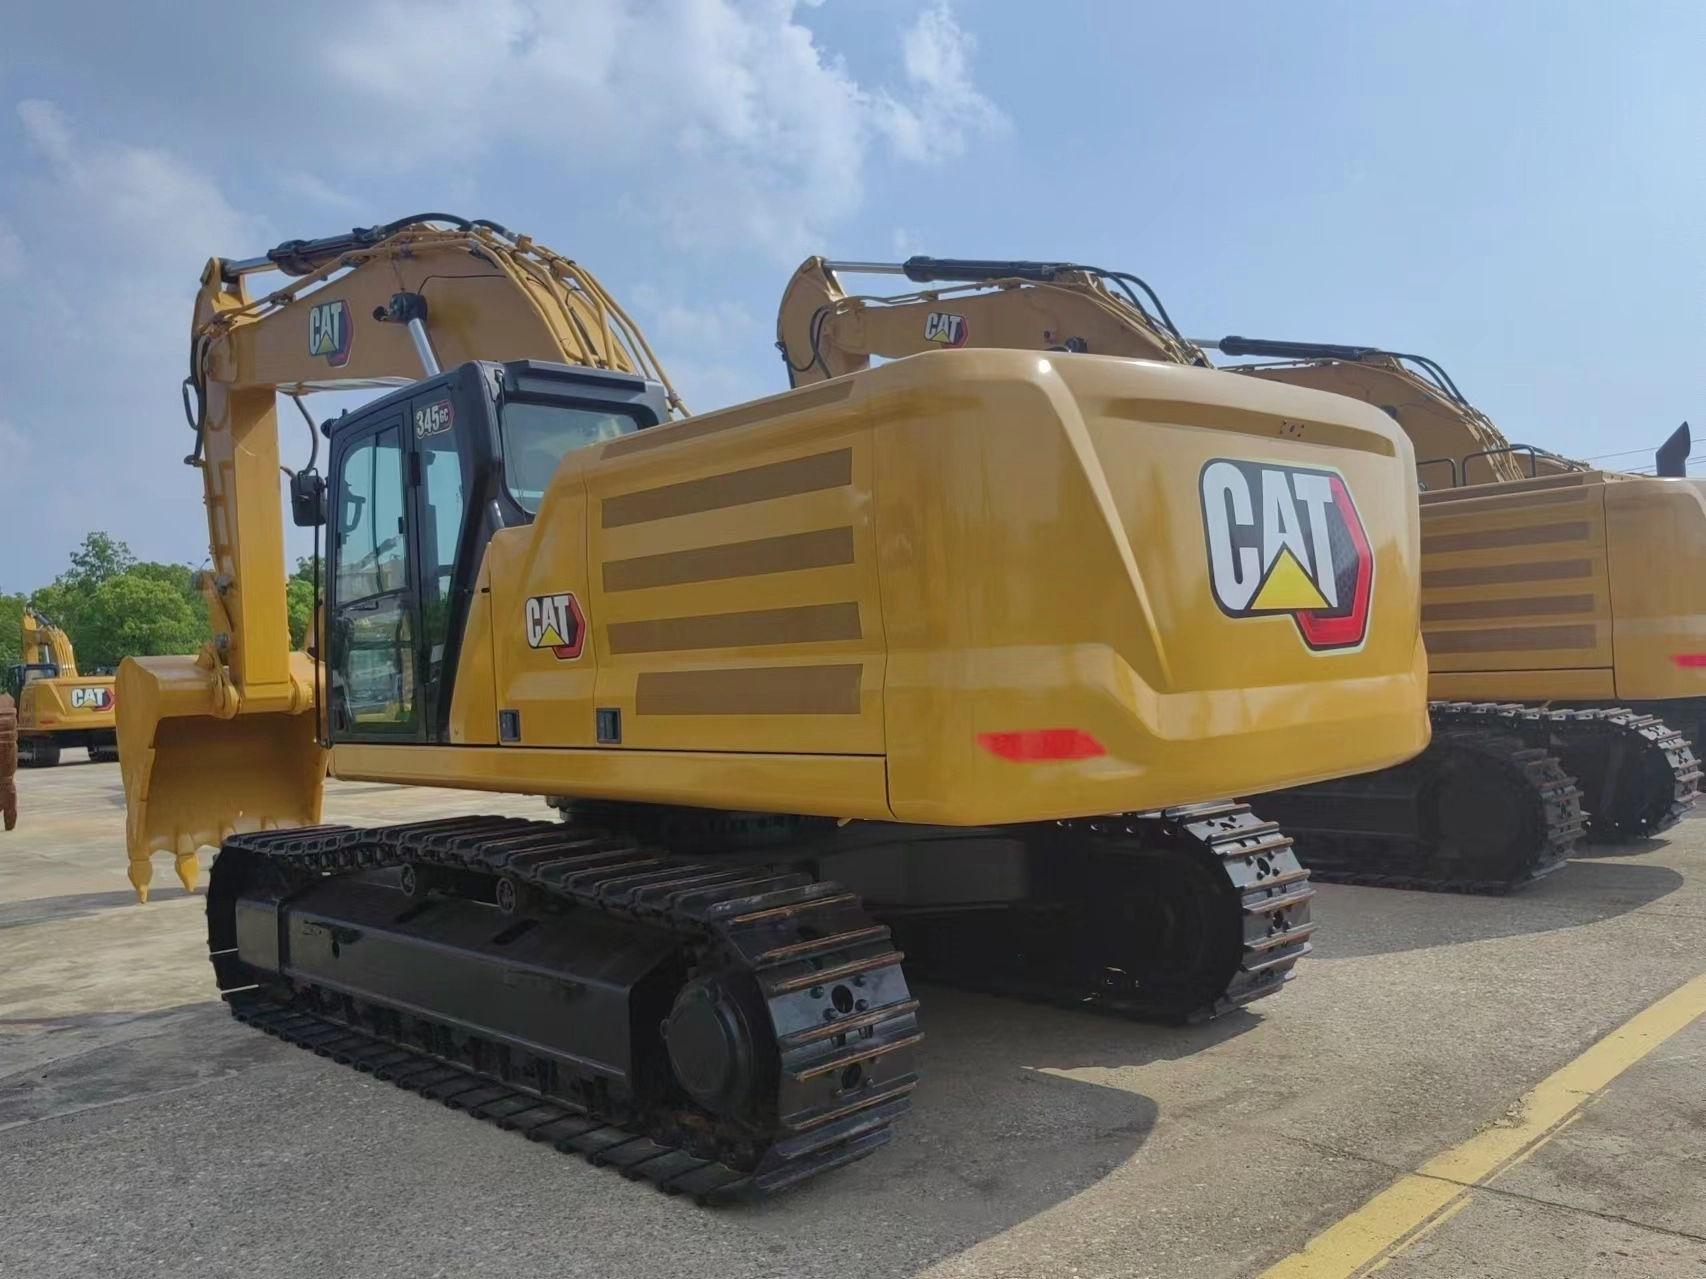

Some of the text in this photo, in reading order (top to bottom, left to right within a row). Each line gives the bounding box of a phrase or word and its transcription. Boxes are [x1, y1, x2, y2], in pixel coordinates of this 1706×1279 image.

[310, 302, 342, 355] CAT
[924, 312, 961, 345] CAT
[1202, 461, 1339, 611] CAT
[526, 595, 570, 648] CAT
[71, 688, 105, 708] CAT
